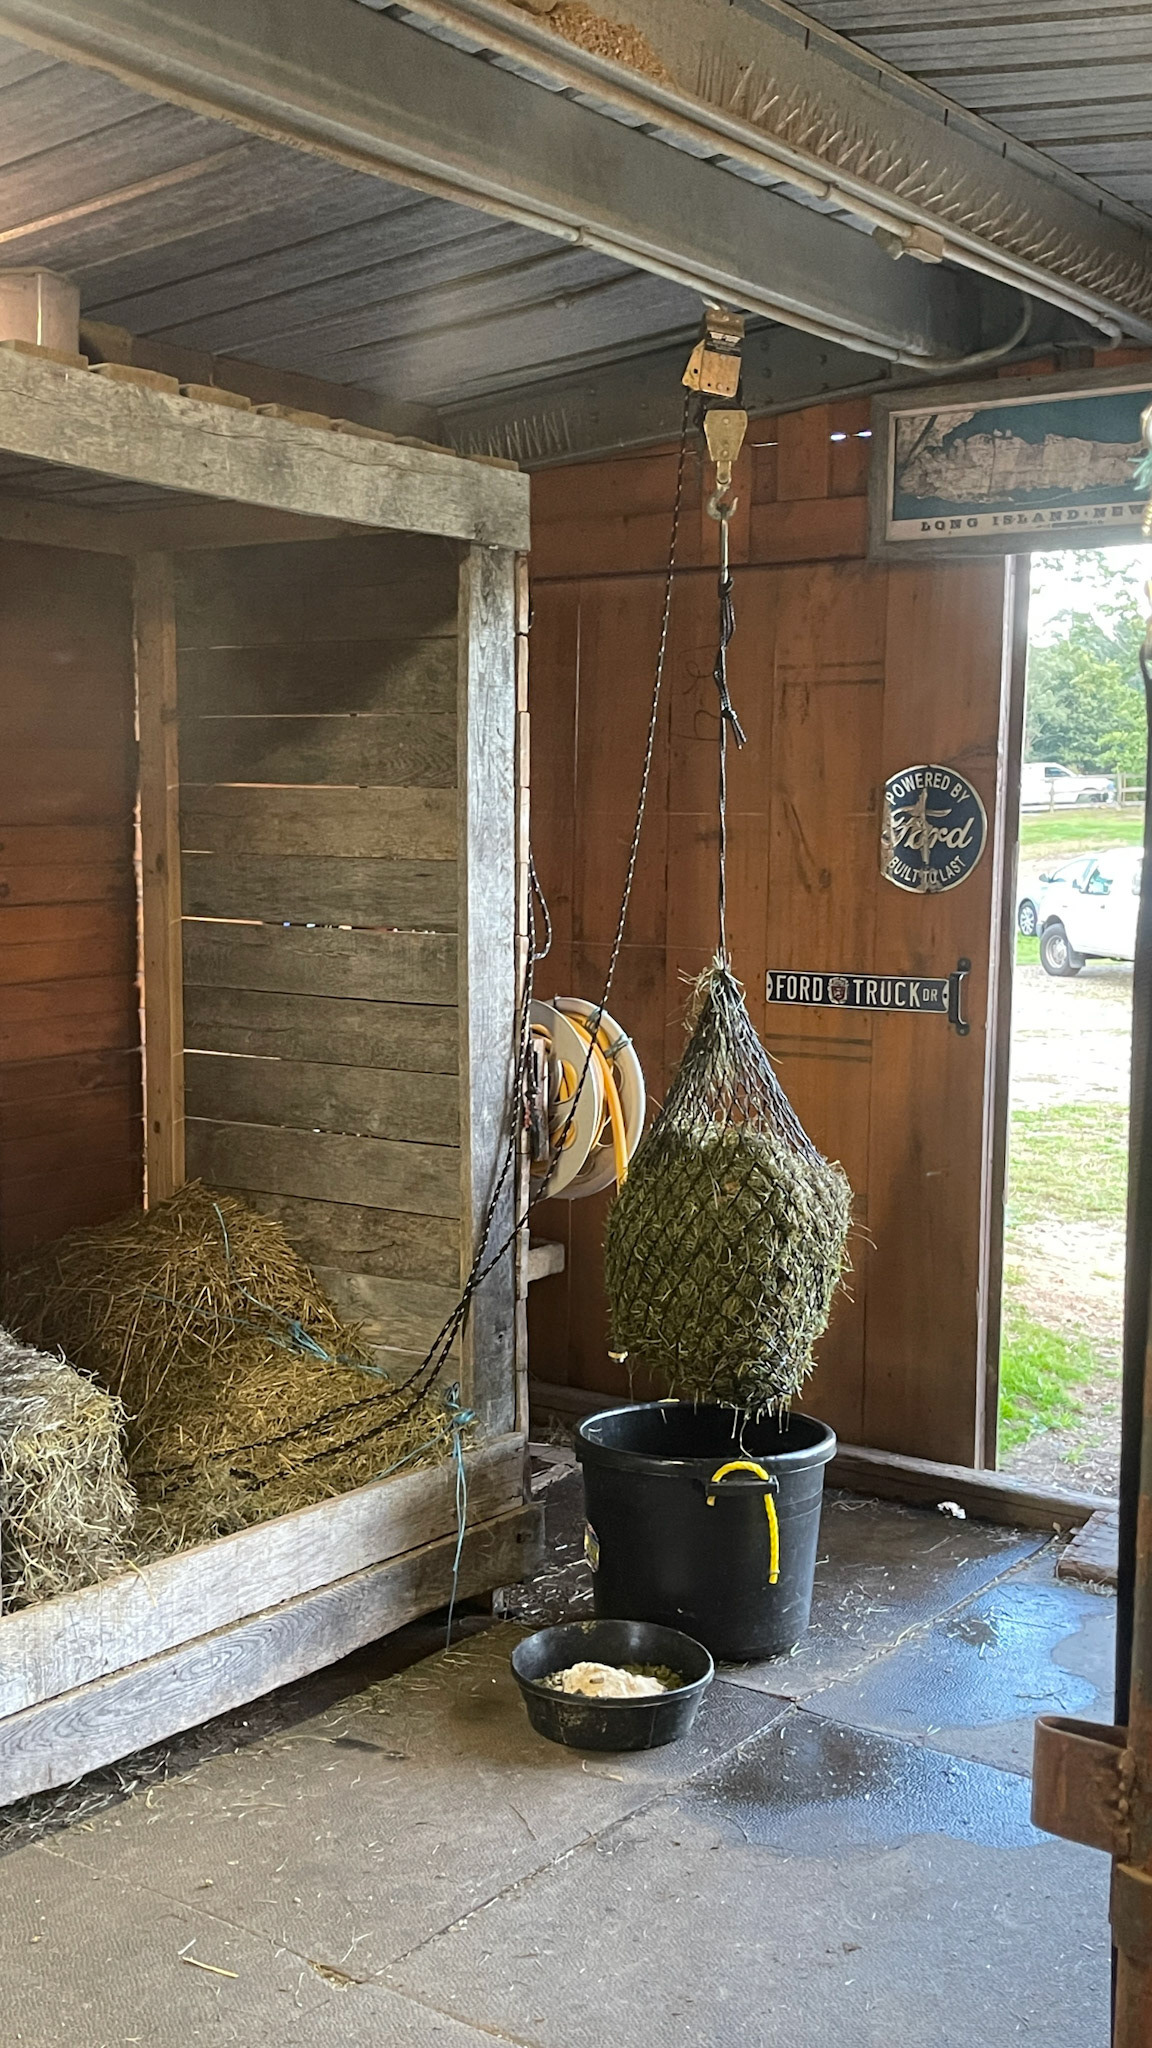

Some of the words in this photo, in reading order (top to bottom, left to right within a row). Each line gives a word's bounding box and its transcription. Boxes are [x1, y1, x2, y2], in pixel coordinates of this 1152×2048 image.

[921, 518, 978, 532] LONG
[992, 507, 1079, 526] ISLAND
[885, 772, 951, 806] POWERED
[949, 783, 971, 804] BY
[881, 808, 975, 849] Ford
[888, 855, 921, 883] BUILT
[923, 871, 938, 883] TO
[939, 855, 966, 882] LAST
[775, 974, 824, 1002] FORD
[852, 979, 921, 1008] TRUCK
[922, 988, 938, 1002] DR
